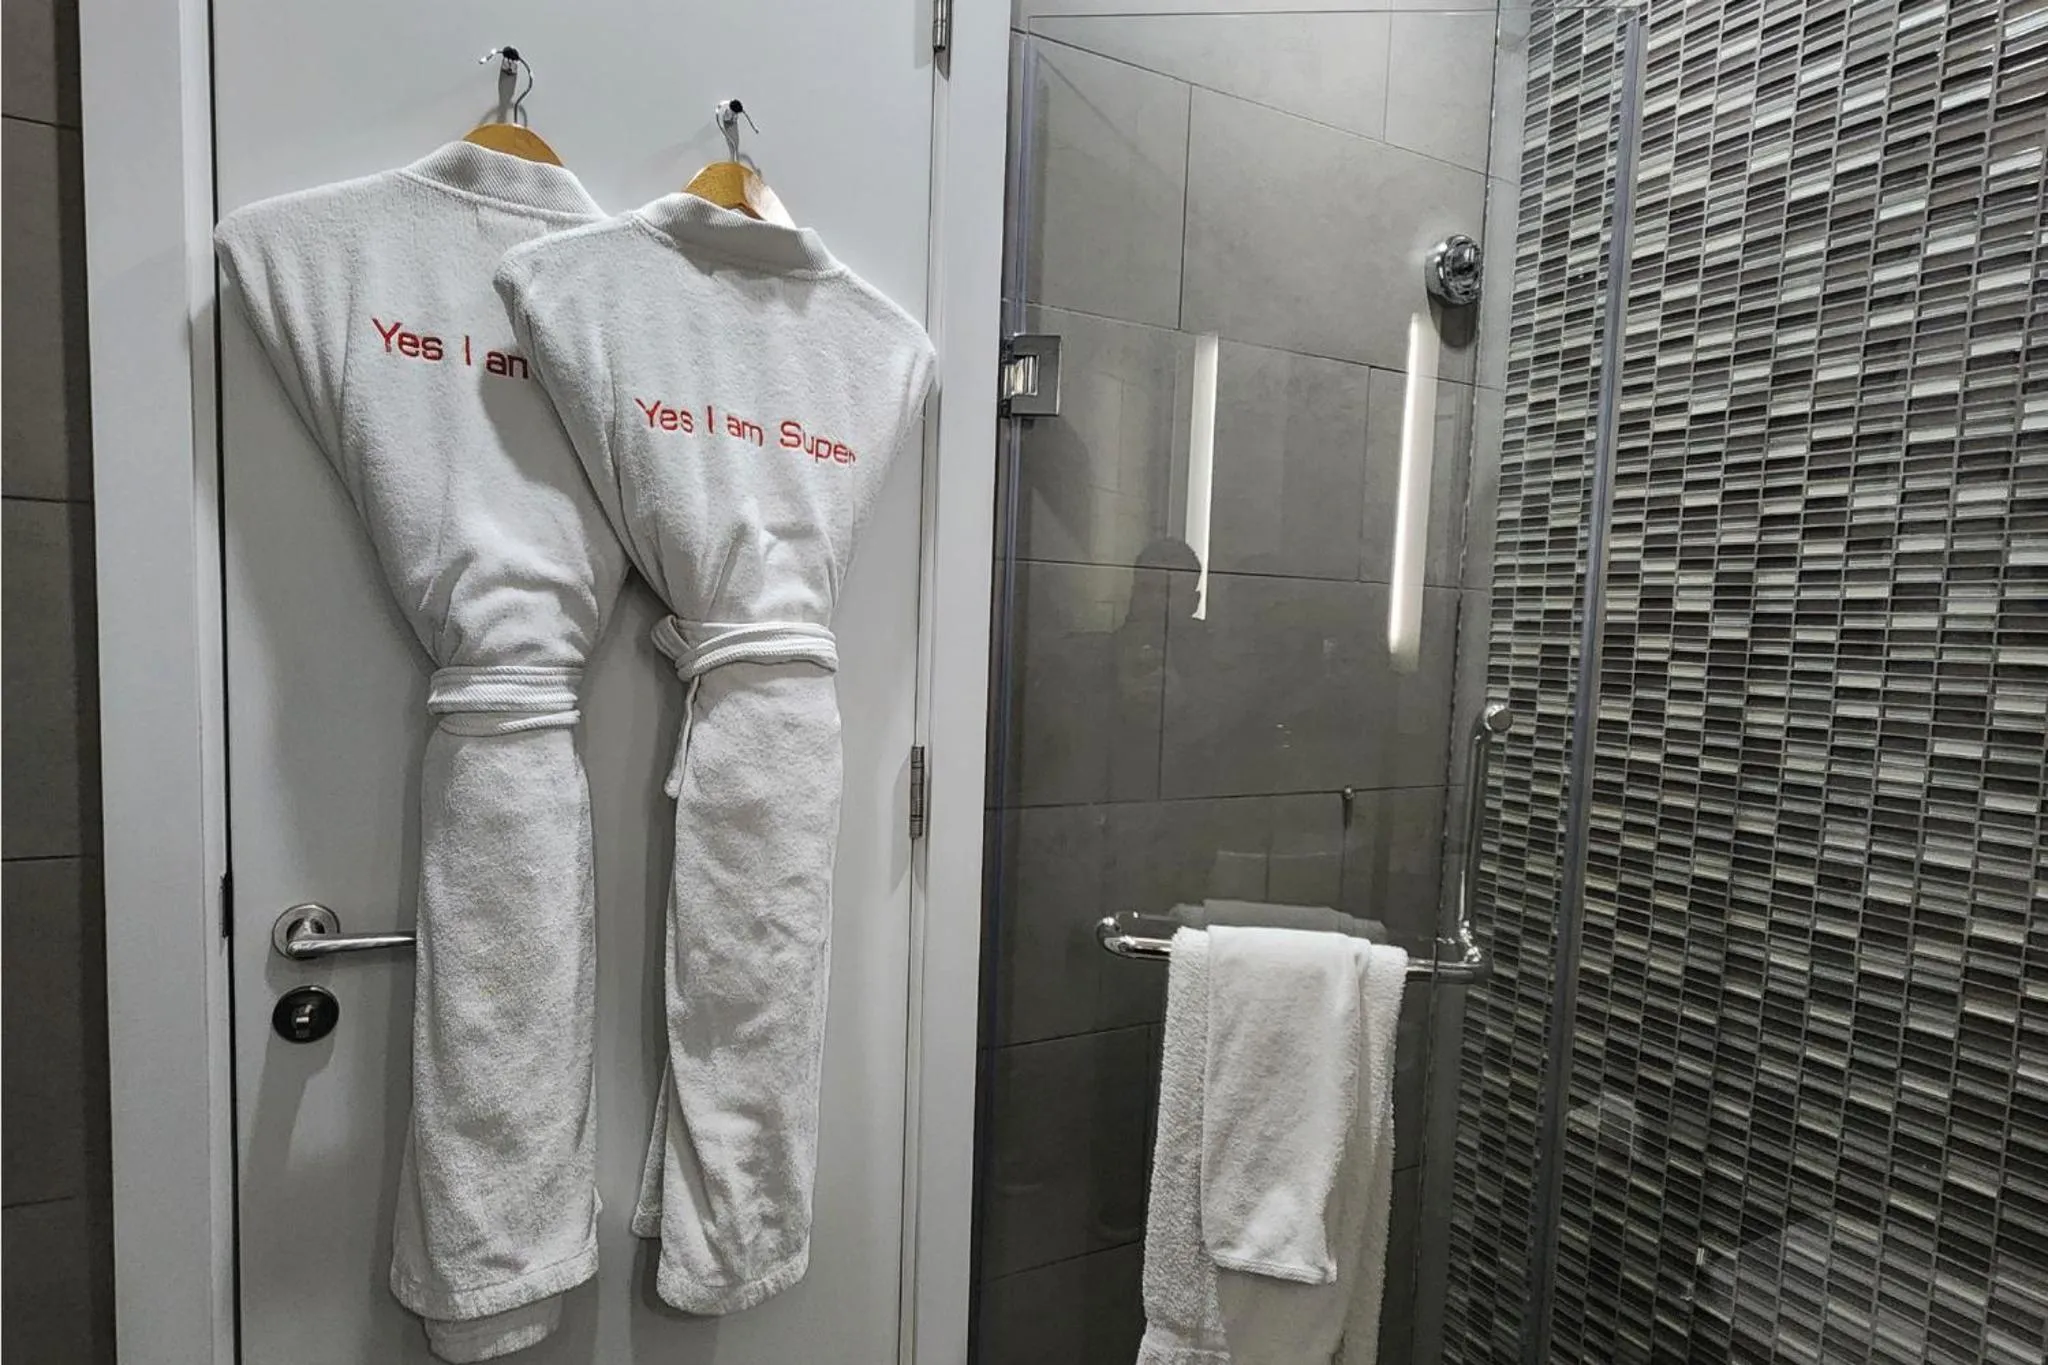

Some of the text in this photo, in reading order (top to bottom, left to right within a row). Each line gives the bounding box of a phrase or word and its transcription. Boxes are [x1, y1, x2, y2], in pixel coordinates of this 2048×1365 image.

[371, 317, 443, 361] Yes
[463, 334, 472, 366] I
[635, 397, 857, 466] Yes I am Super
